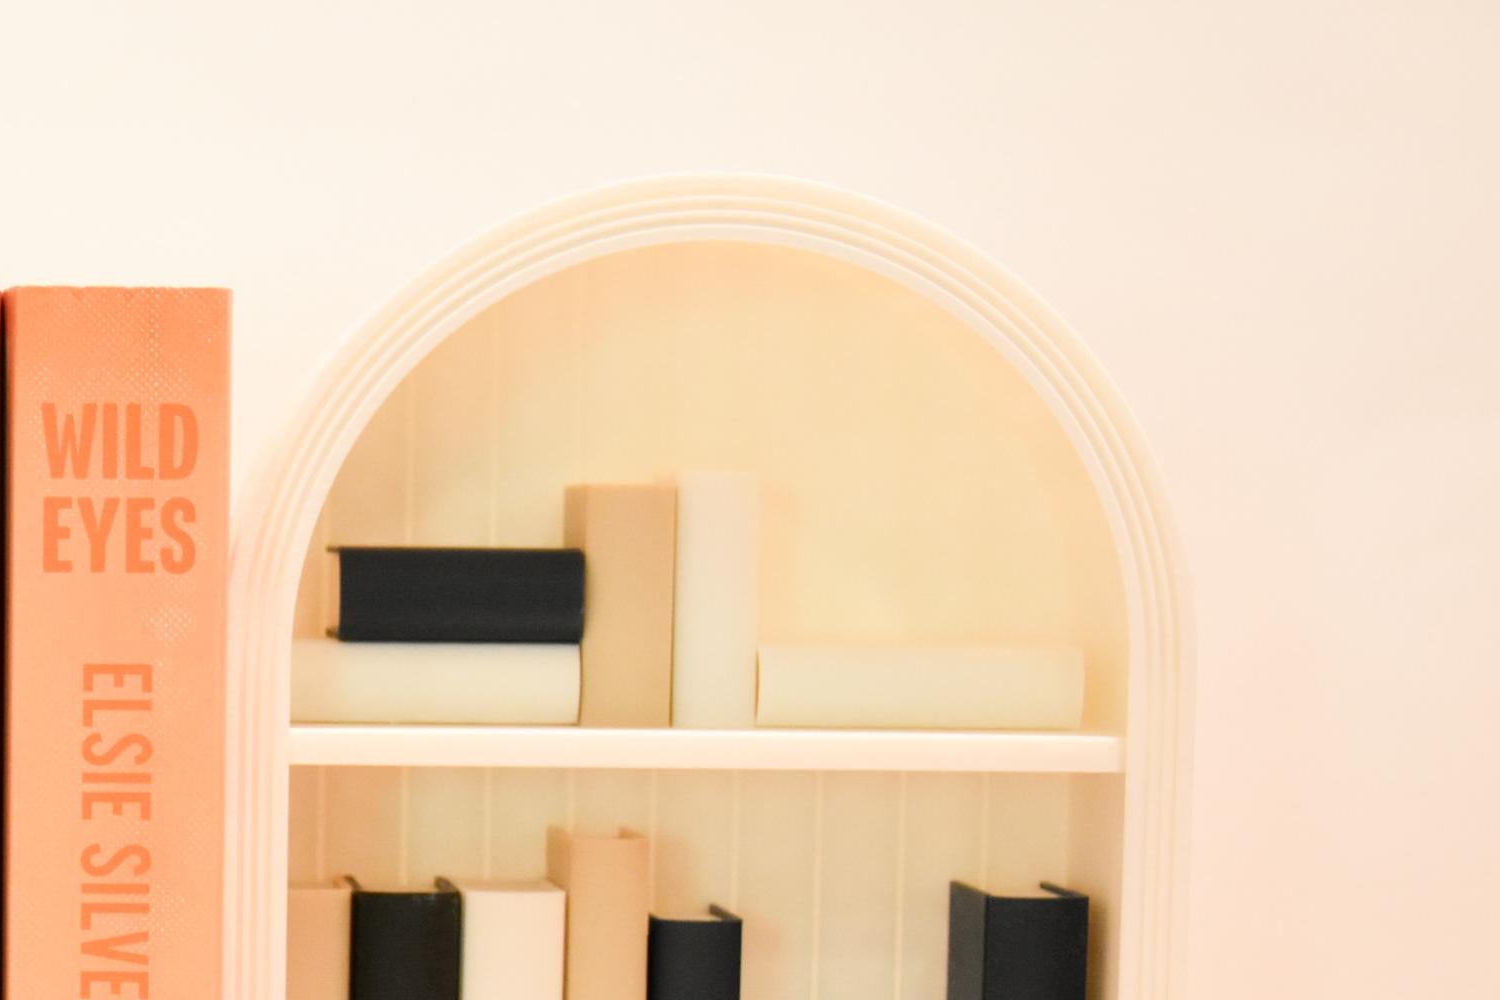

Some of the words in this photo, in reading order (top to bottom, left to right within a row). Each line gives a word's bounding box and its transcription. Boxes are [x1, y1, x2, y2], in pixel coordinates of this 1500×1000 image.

[41, 402, 199, 480] WILD
[42, 496, 197, 574] EYES
[81, 663, 153, 821] ELSIE
